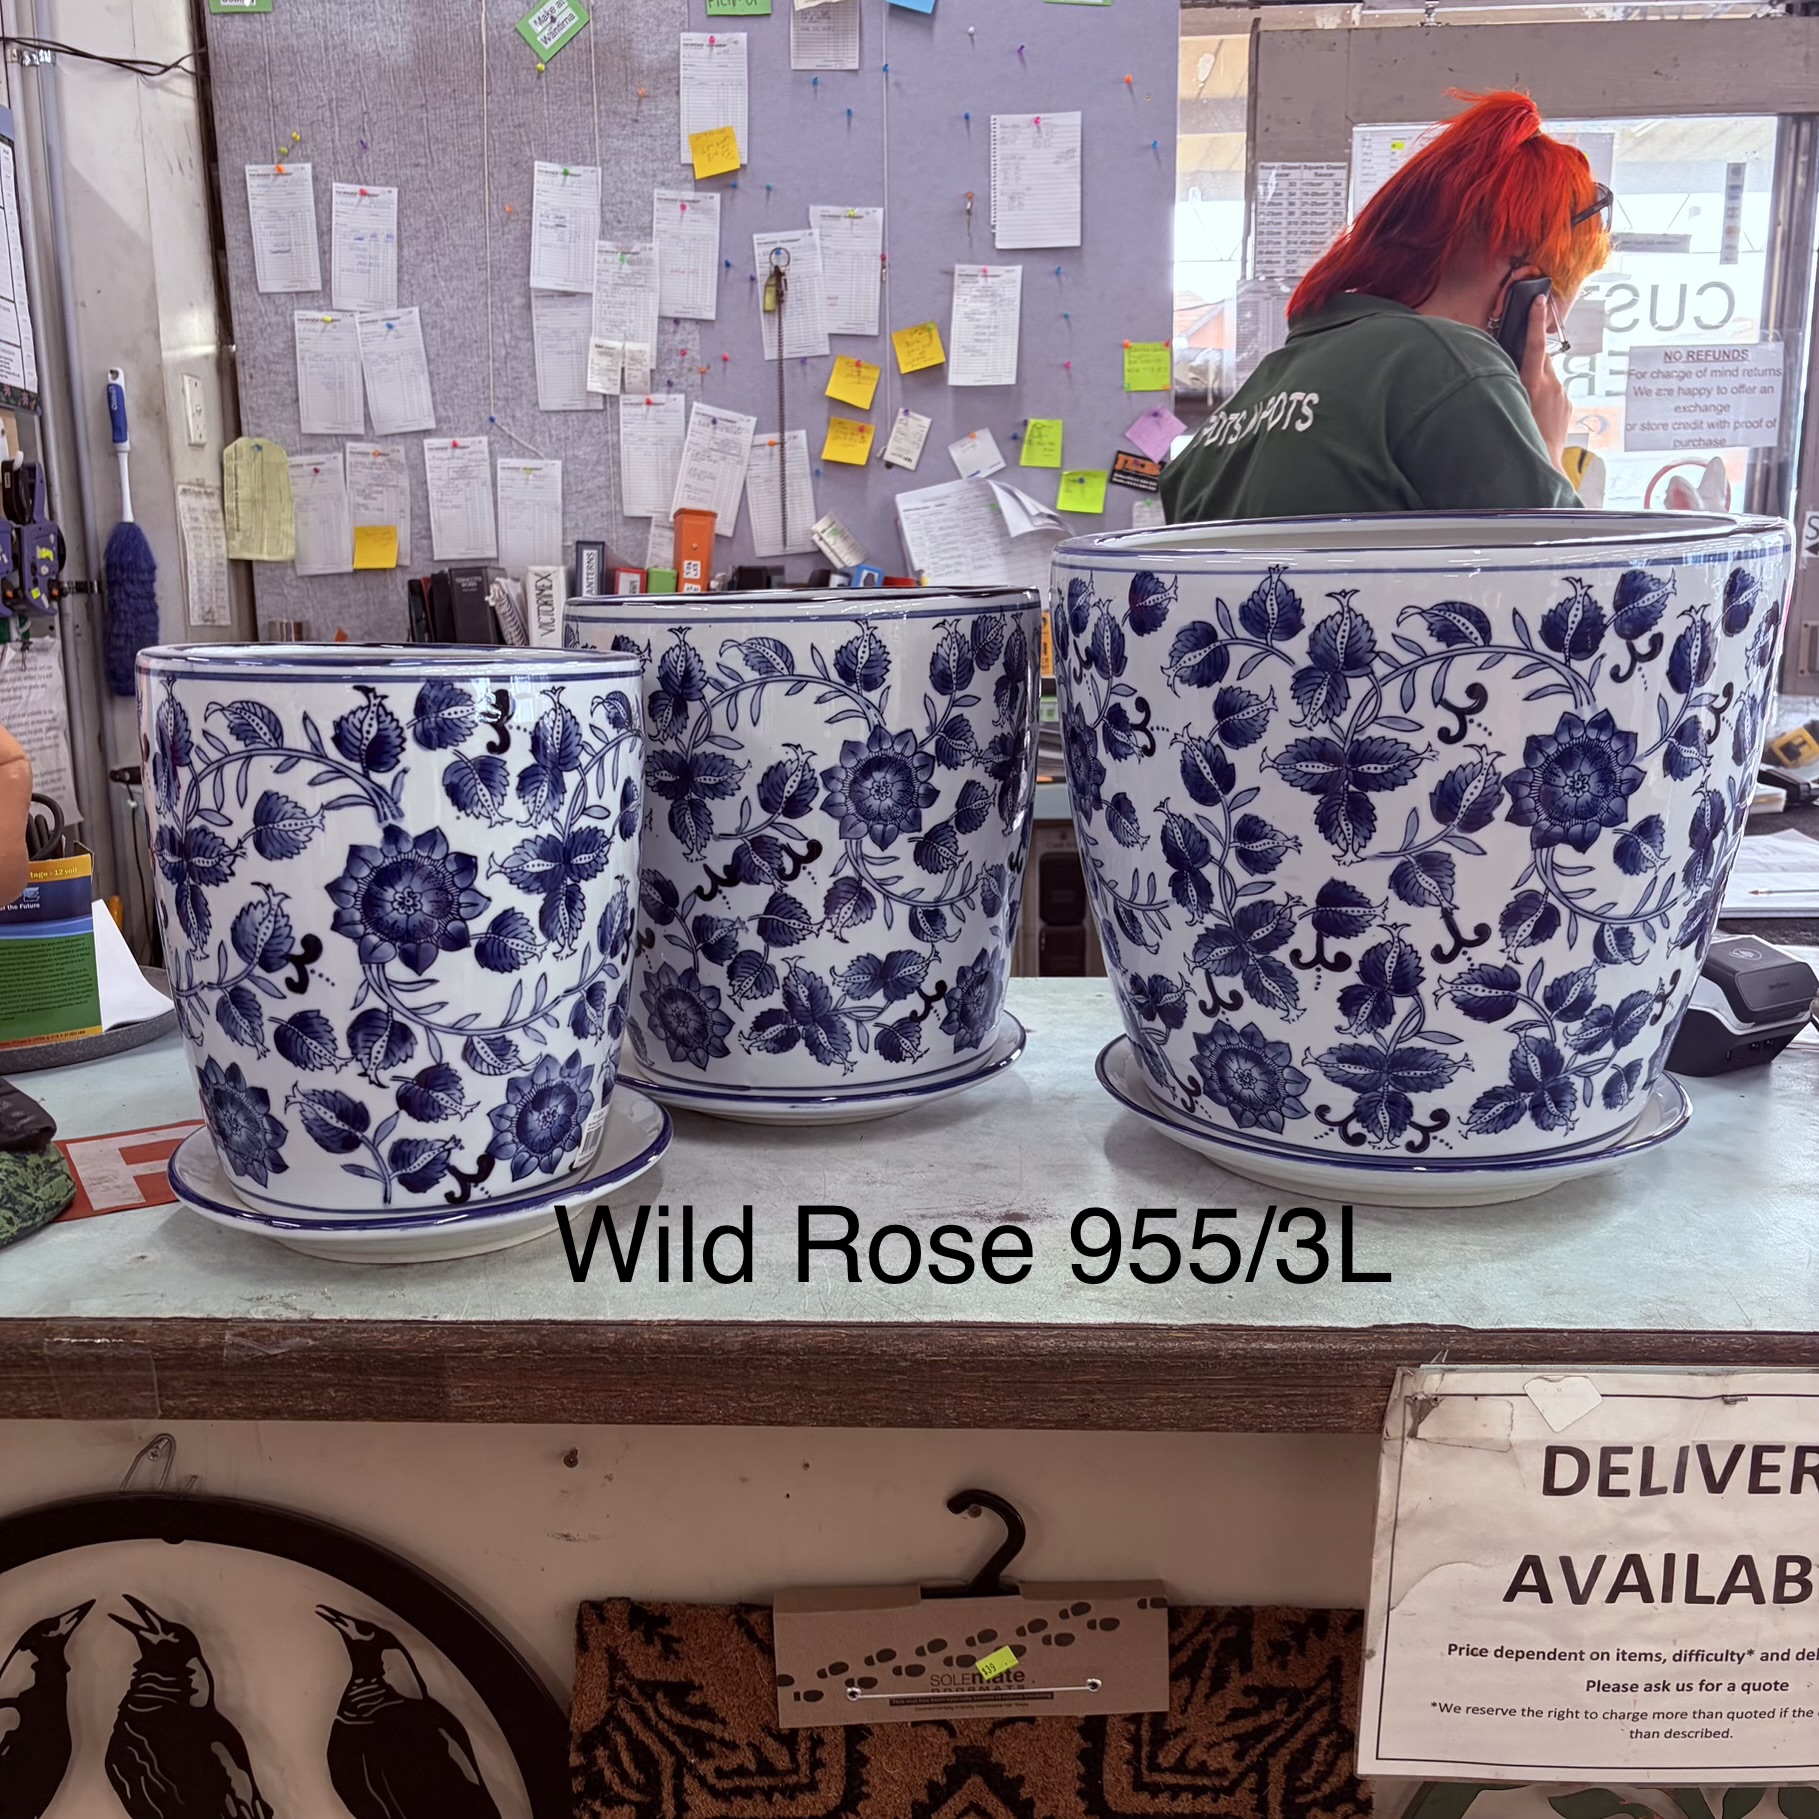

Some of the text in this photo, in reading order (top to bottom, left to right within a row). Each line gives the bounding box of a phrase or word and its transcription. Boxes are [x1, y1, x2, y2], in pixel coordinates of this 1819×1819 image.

[1664, 349, 1749, 362] NO REFUNDS
[1629, 367, 1782, 381] For change of mind returns
[1633, 385, 1774, 398] We are happy to offer an
[1674, 403, 1731, 415] exchange
[1625, 417, 1777, 431] or store credit with proof of
[1673, 437, 1727, 448] purchase
[1543, 1443, 1819, 1498] DELIVER
[1503, 1552, 1813, 1605] AVAILAB
[1448, 1643, 1489, 1657] Price
[1493, 1645, 1585, 1662] dependent
[1589, 1650, 1610, 1661] on
[1616, 1648, 1667, 1664] items,
[1760, 1649, 1791, 1661] and
[981, 1662, 997, 1676] $39
[1585, 1679, 1790, 1695] Please ask us for a quote
[1466, 1705, 1516, 1717] reserve
[1521, 1707, 1544, 1718] the
[1548, 1708, 1580, 1721] right
[1584, 1710, 1598, 1720] to
[1602, 1709, 1648, 1722] charge
[1652, 1711, 1688, 1720] more
[1692, 1709, 1723, 1720] than
[1726, 1708, 1776, 1721] quoted
[1779, 1707, 1789, 1718] if
[1792, 1707, 1814, 1718] the
[1629, 1728, 1734, 1739] than described.
